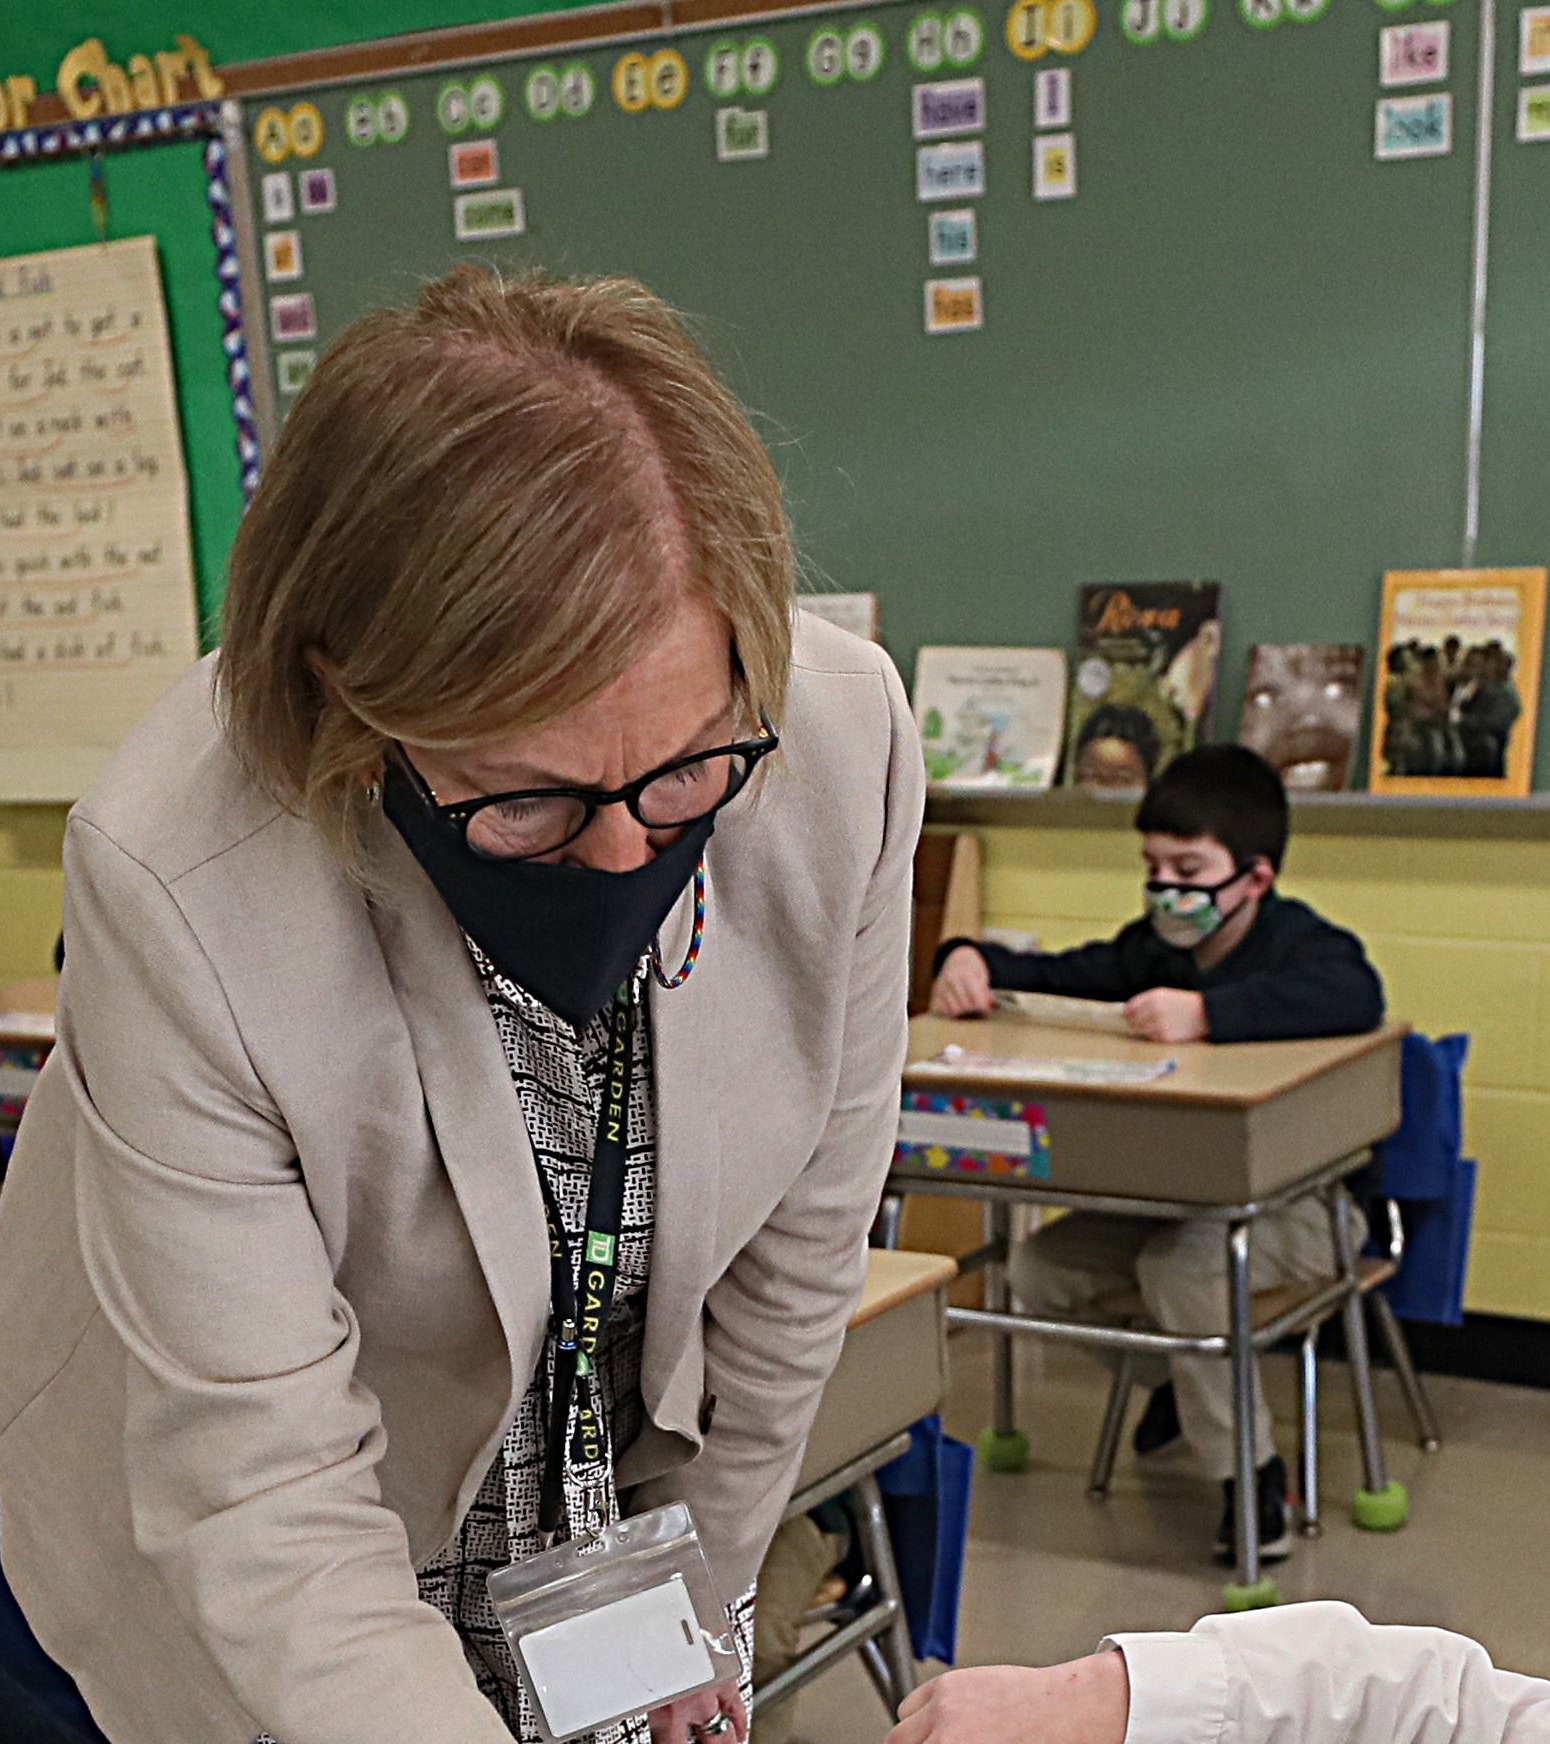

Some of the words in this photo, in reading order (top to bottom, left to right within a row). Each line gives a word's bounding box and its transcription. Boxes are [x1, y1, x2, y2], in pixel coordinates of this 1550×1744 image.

[57, 34, 225, 121] Chart
[605, 1010, 628, 1144] GARDEN
[591, 1236, 613, 1263] TD
